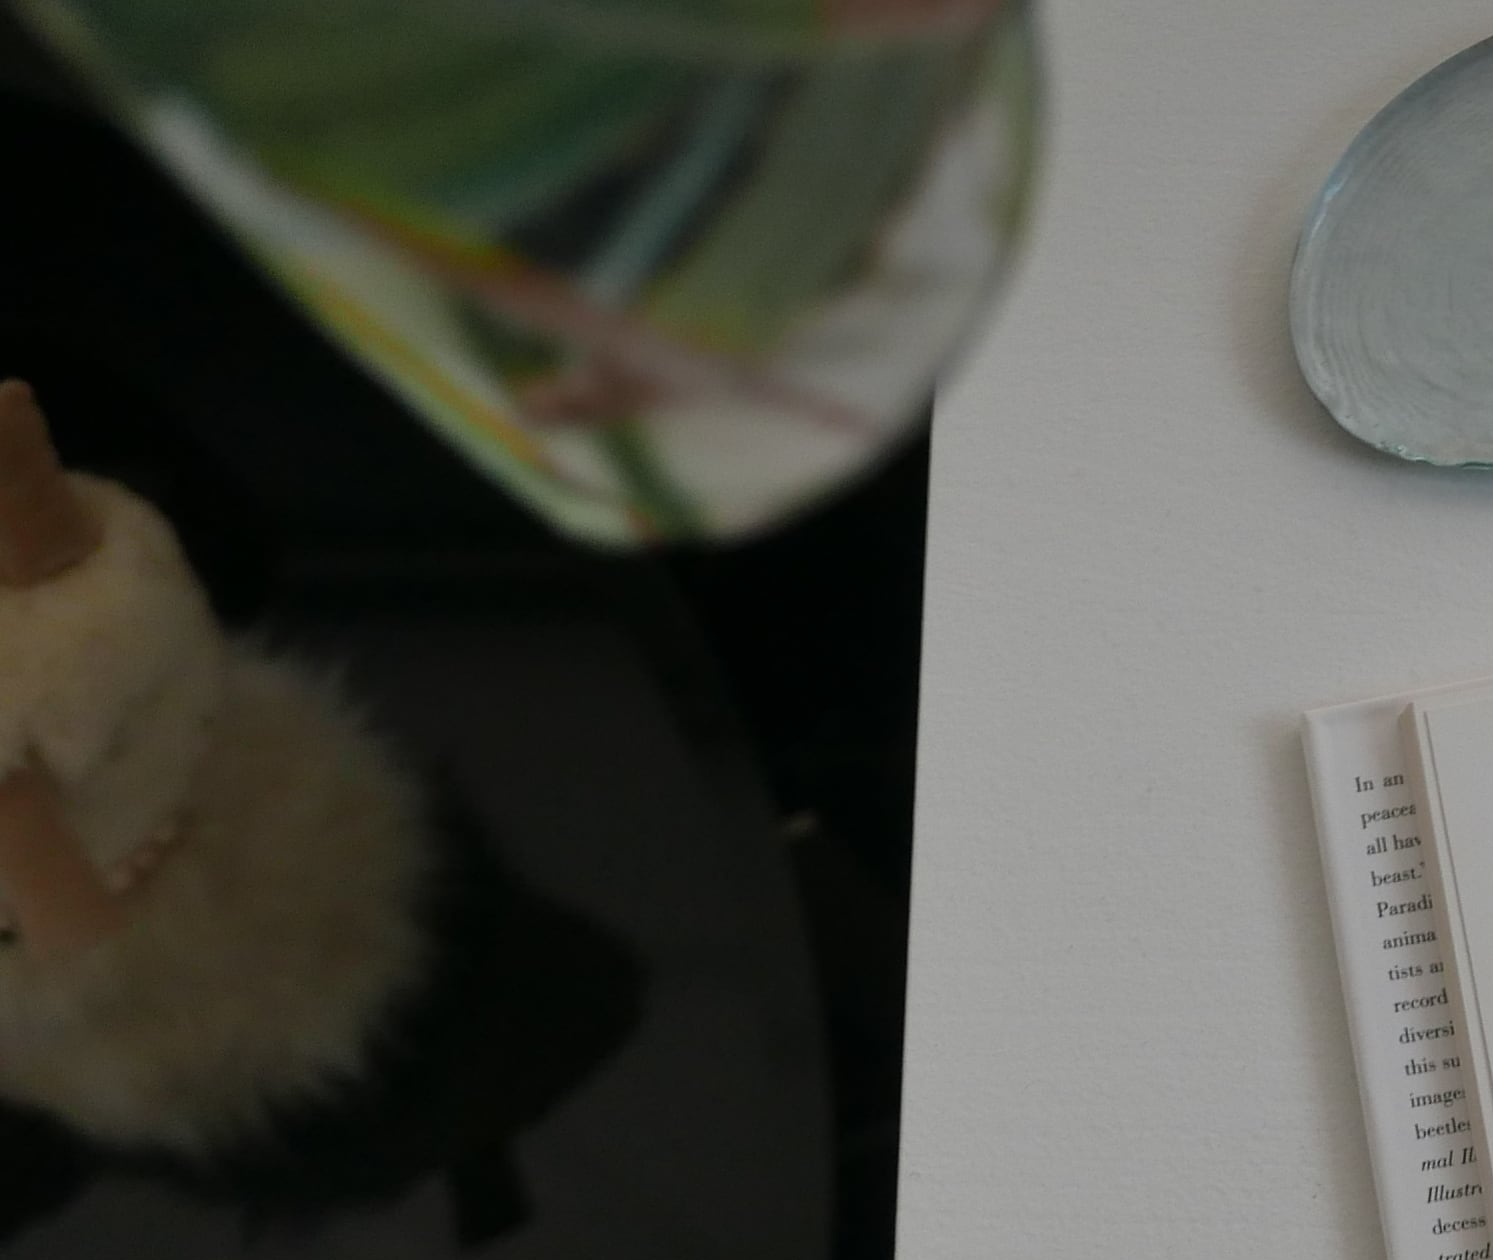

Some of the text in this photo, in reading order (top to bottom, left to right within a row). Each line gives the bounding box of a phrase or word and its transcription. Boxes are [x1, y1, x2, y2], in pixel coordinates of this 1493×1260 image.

[1354, 774, 1405, 793] In an
[1404, 1057, 1437, 1076] this
